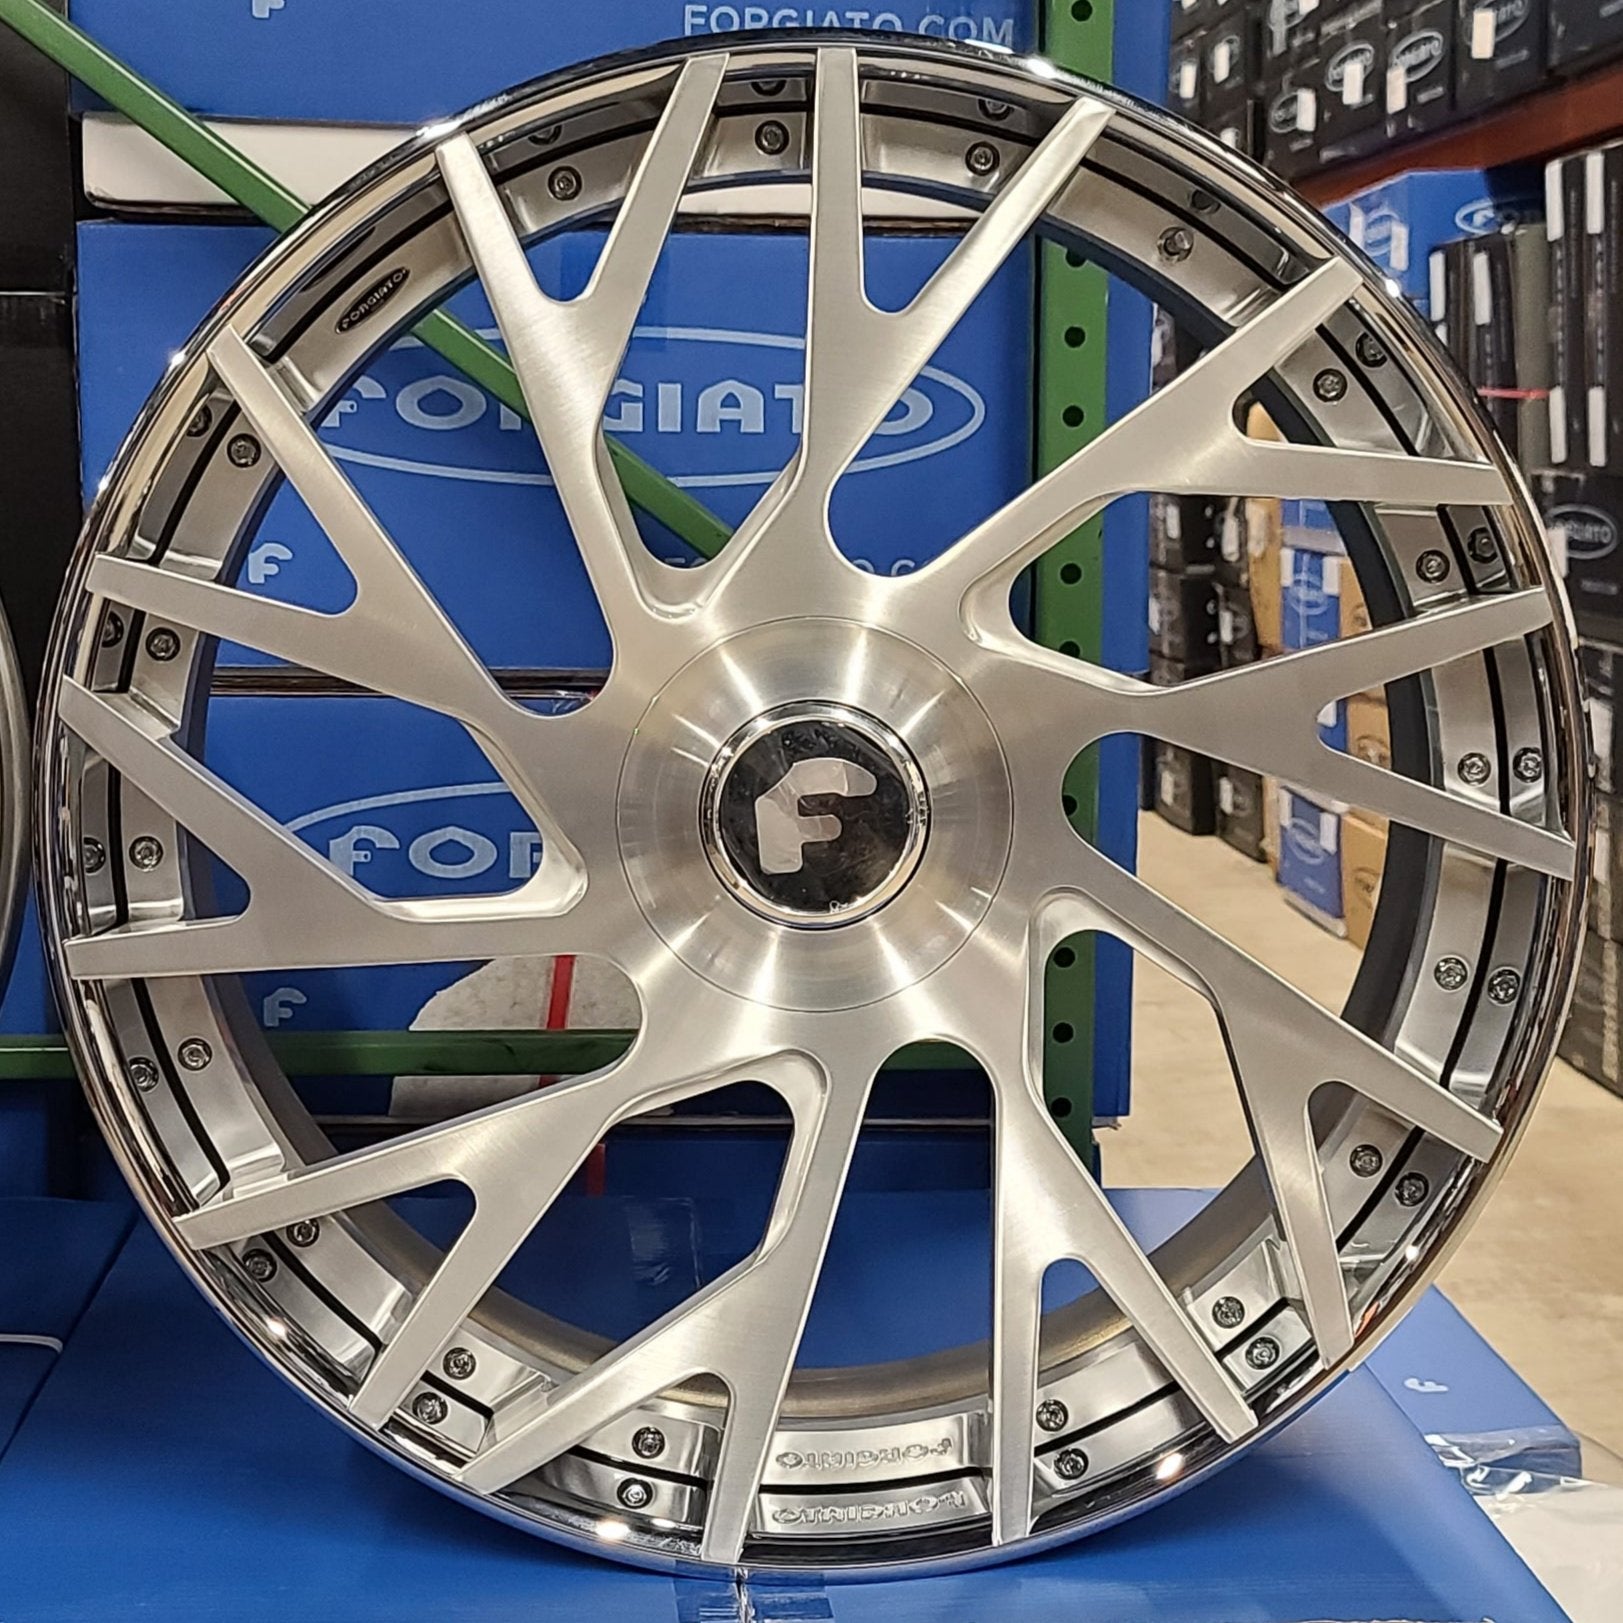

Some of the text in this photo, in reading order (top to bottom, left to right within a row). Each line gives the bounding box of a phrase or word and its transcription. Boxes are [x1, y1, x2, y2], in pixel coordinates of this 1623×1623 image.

[684, 4, 1015, 46] FORGIATOCOM
[321, 375, 933, 435] FOGIAT
[755, 757, 877, 874] F
